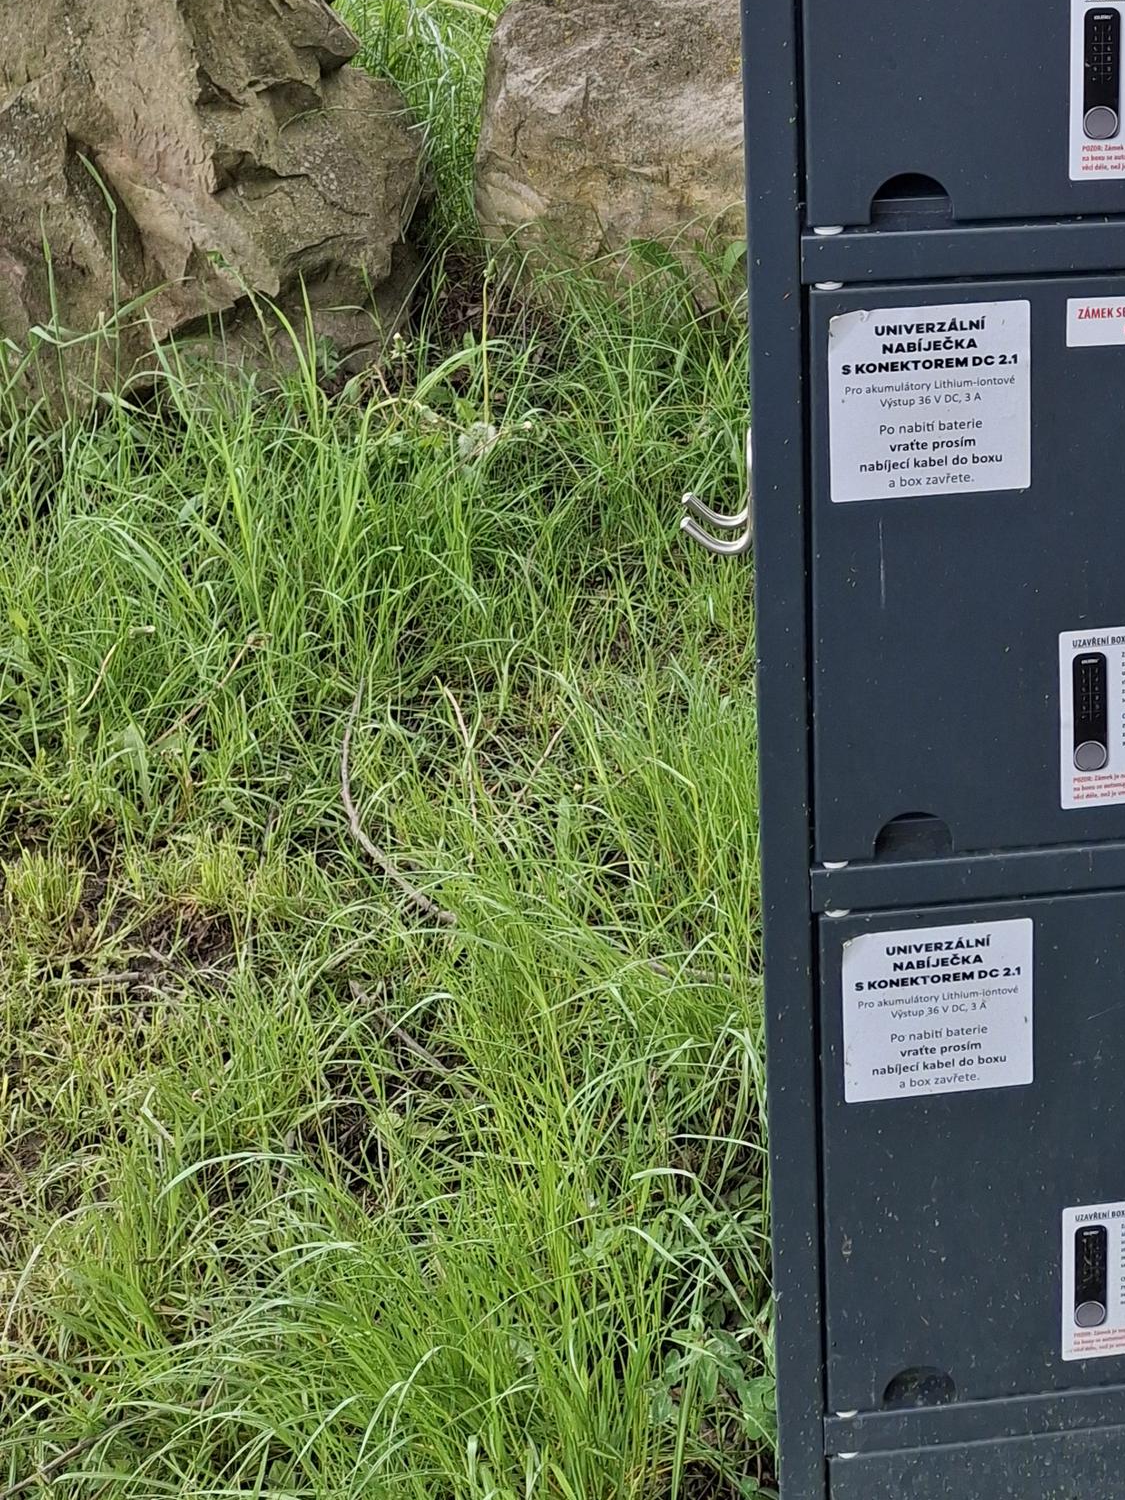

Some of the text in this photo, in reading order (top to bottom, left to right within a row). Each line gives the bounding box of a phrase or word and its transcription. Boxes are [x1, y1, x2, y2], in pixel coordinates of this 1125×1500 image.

[1078, 307, 1113, 319] ZÁMEK
[875, 316, 986, 336] UNIVERZÁLNÍ
[882, 336, 977, 354] NABÍJEČKA
[842, 354, 1018, 375] S KONEKTOREM DC 2.1
[845, 375, 1015, 395] Pro akumulátory Lithium-iontové
[880, 392, 982, 409] Výstup 36 V DC, 3 A
[879, 418, 983, 435] Po nabití baterie
[889, 436, 976, 452] vraťte prosím
[860, 453, 1002, 473] nabíjecí kabel do boxu
[888, 473, 974, 488] a box zavřete.
[1072, 635, 1110, 648] UZAVŘENÍ
[885, 934, 992, 956] UNIVERZÁLNÍ
[893, 953, 984, 972] NABÍJEČKA
[855, 966, 1021, 991] S KONEKTOREM DC 2.1
[858, 985, 1018, 1009] Pro akumulátory Lithium-iontové
[891, 1001, 987, 1020] Výstup 36 V DC, 3 A
[890, 1025, 988, 1043] Po nabití baterie
[900, 1041, 982, 1057] vraťte prosím
[872, 1055, 1007, 1076] nabíjecí kabel do boxu
[899, 1073, 980, 1089] a box zavřete.
